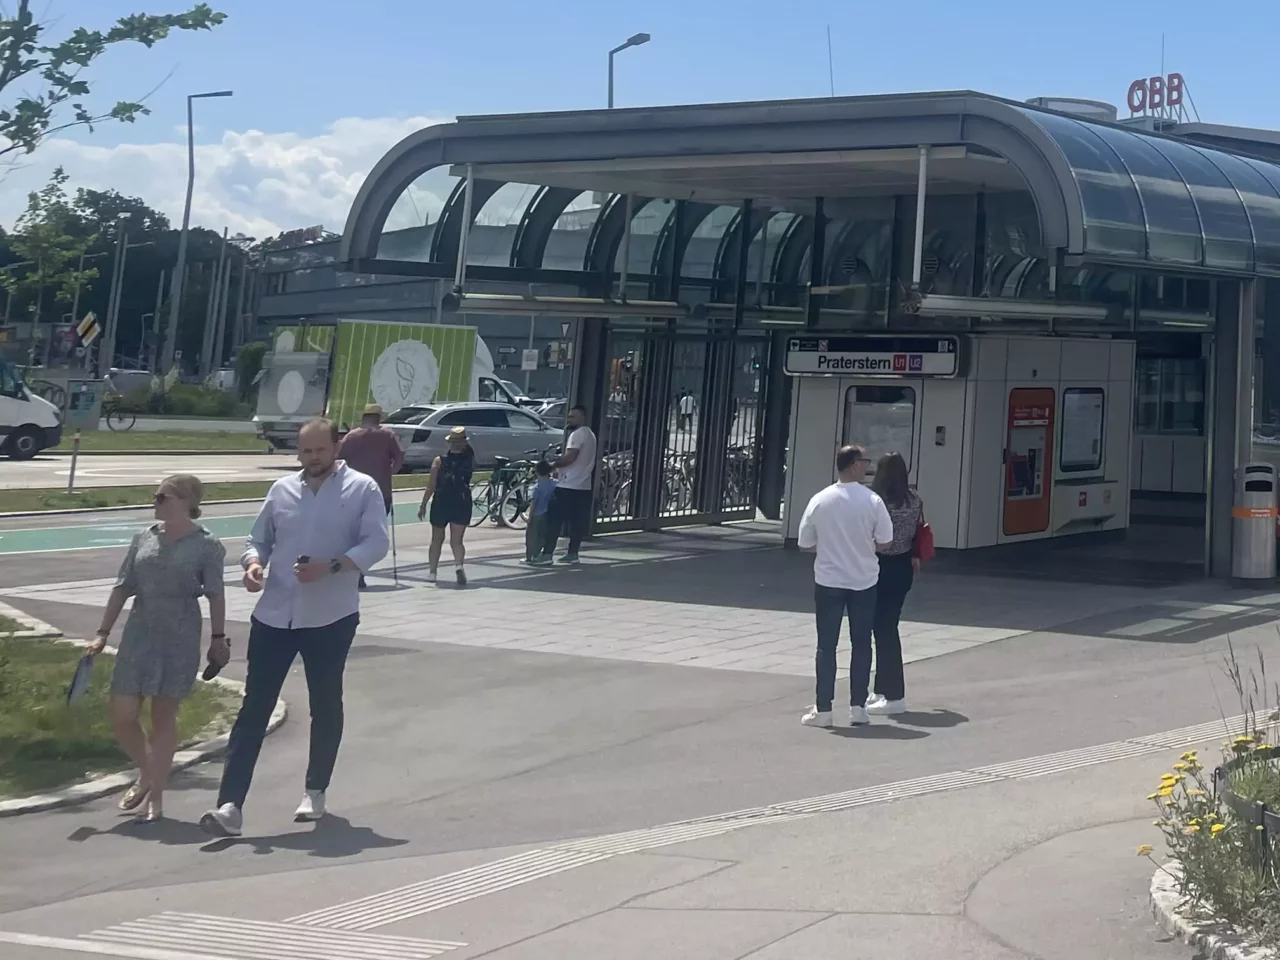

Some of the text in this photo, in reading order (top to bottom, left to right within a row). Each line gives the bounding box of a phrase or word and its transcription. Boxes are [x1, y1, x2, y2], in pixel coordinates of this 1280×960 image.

[817, 355, 921, 370] Praterstern U1 U2
